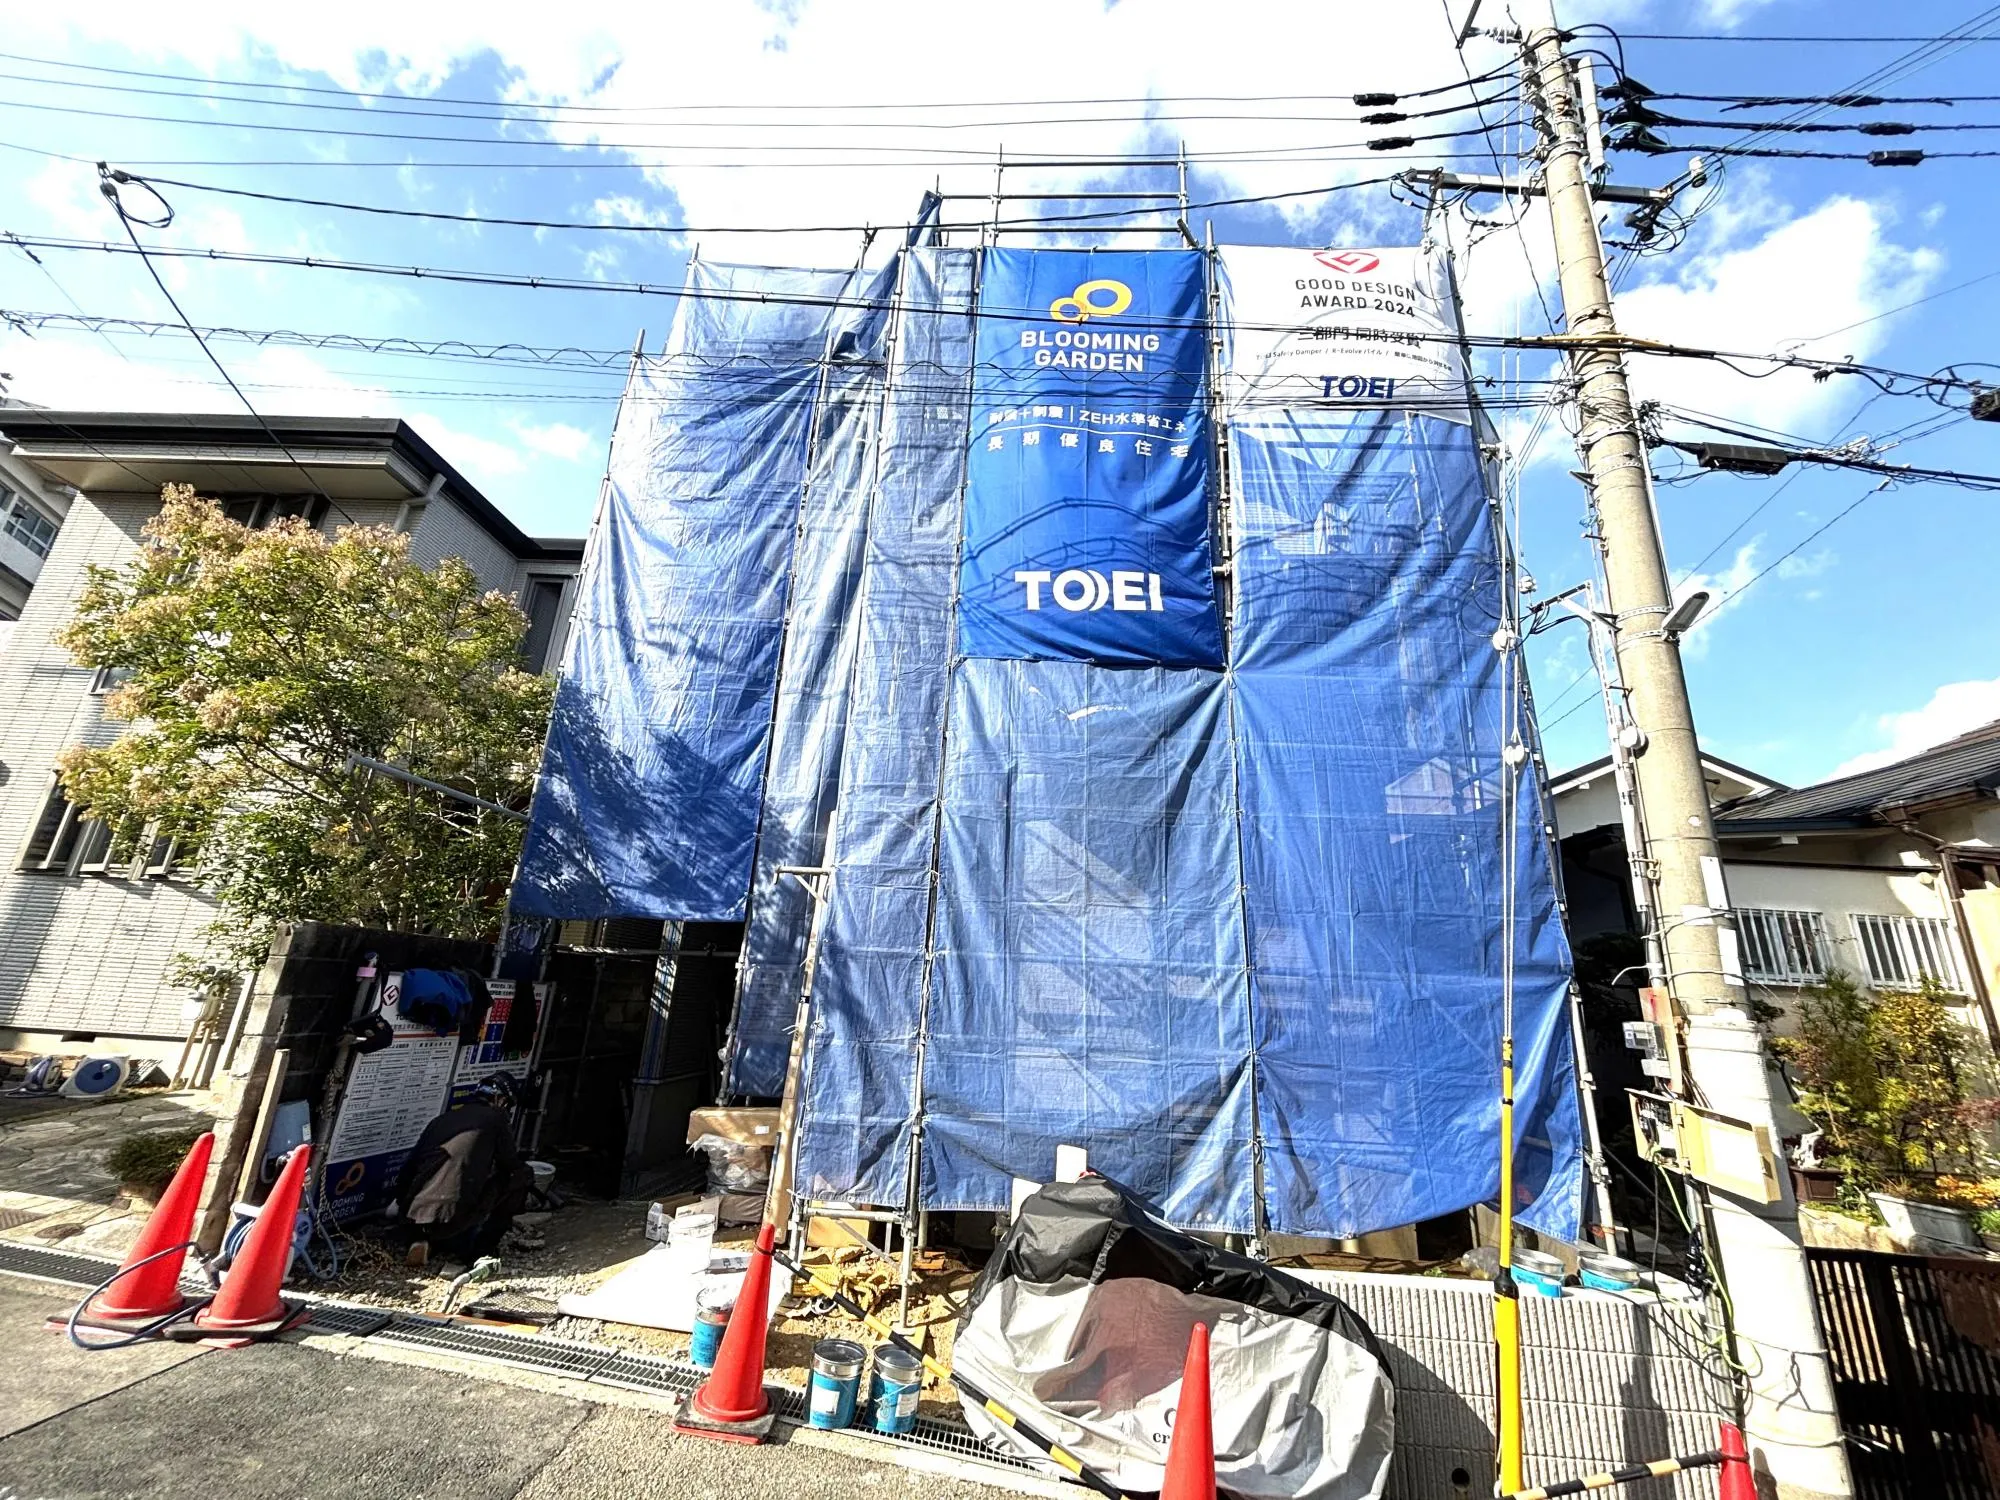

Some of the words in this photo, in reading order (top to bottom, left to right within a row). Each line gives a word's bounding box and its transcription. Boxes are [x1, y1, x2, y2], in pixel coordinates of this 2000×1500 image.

[1295, 278, 1345, 290] GOOD
[1352, 281, 1415, 301] DESIGN
[1300, 295, 1367, 309] AWARD
[1374, 298, 1415, 317] 2024
[1020, 330, 1160, 352] BLOOMING
[1034, 349, 1143, 372] GARDEN
[1319, 375, 1395, 400] TOEI
[1014, 569, 1164, 612] TOEI
